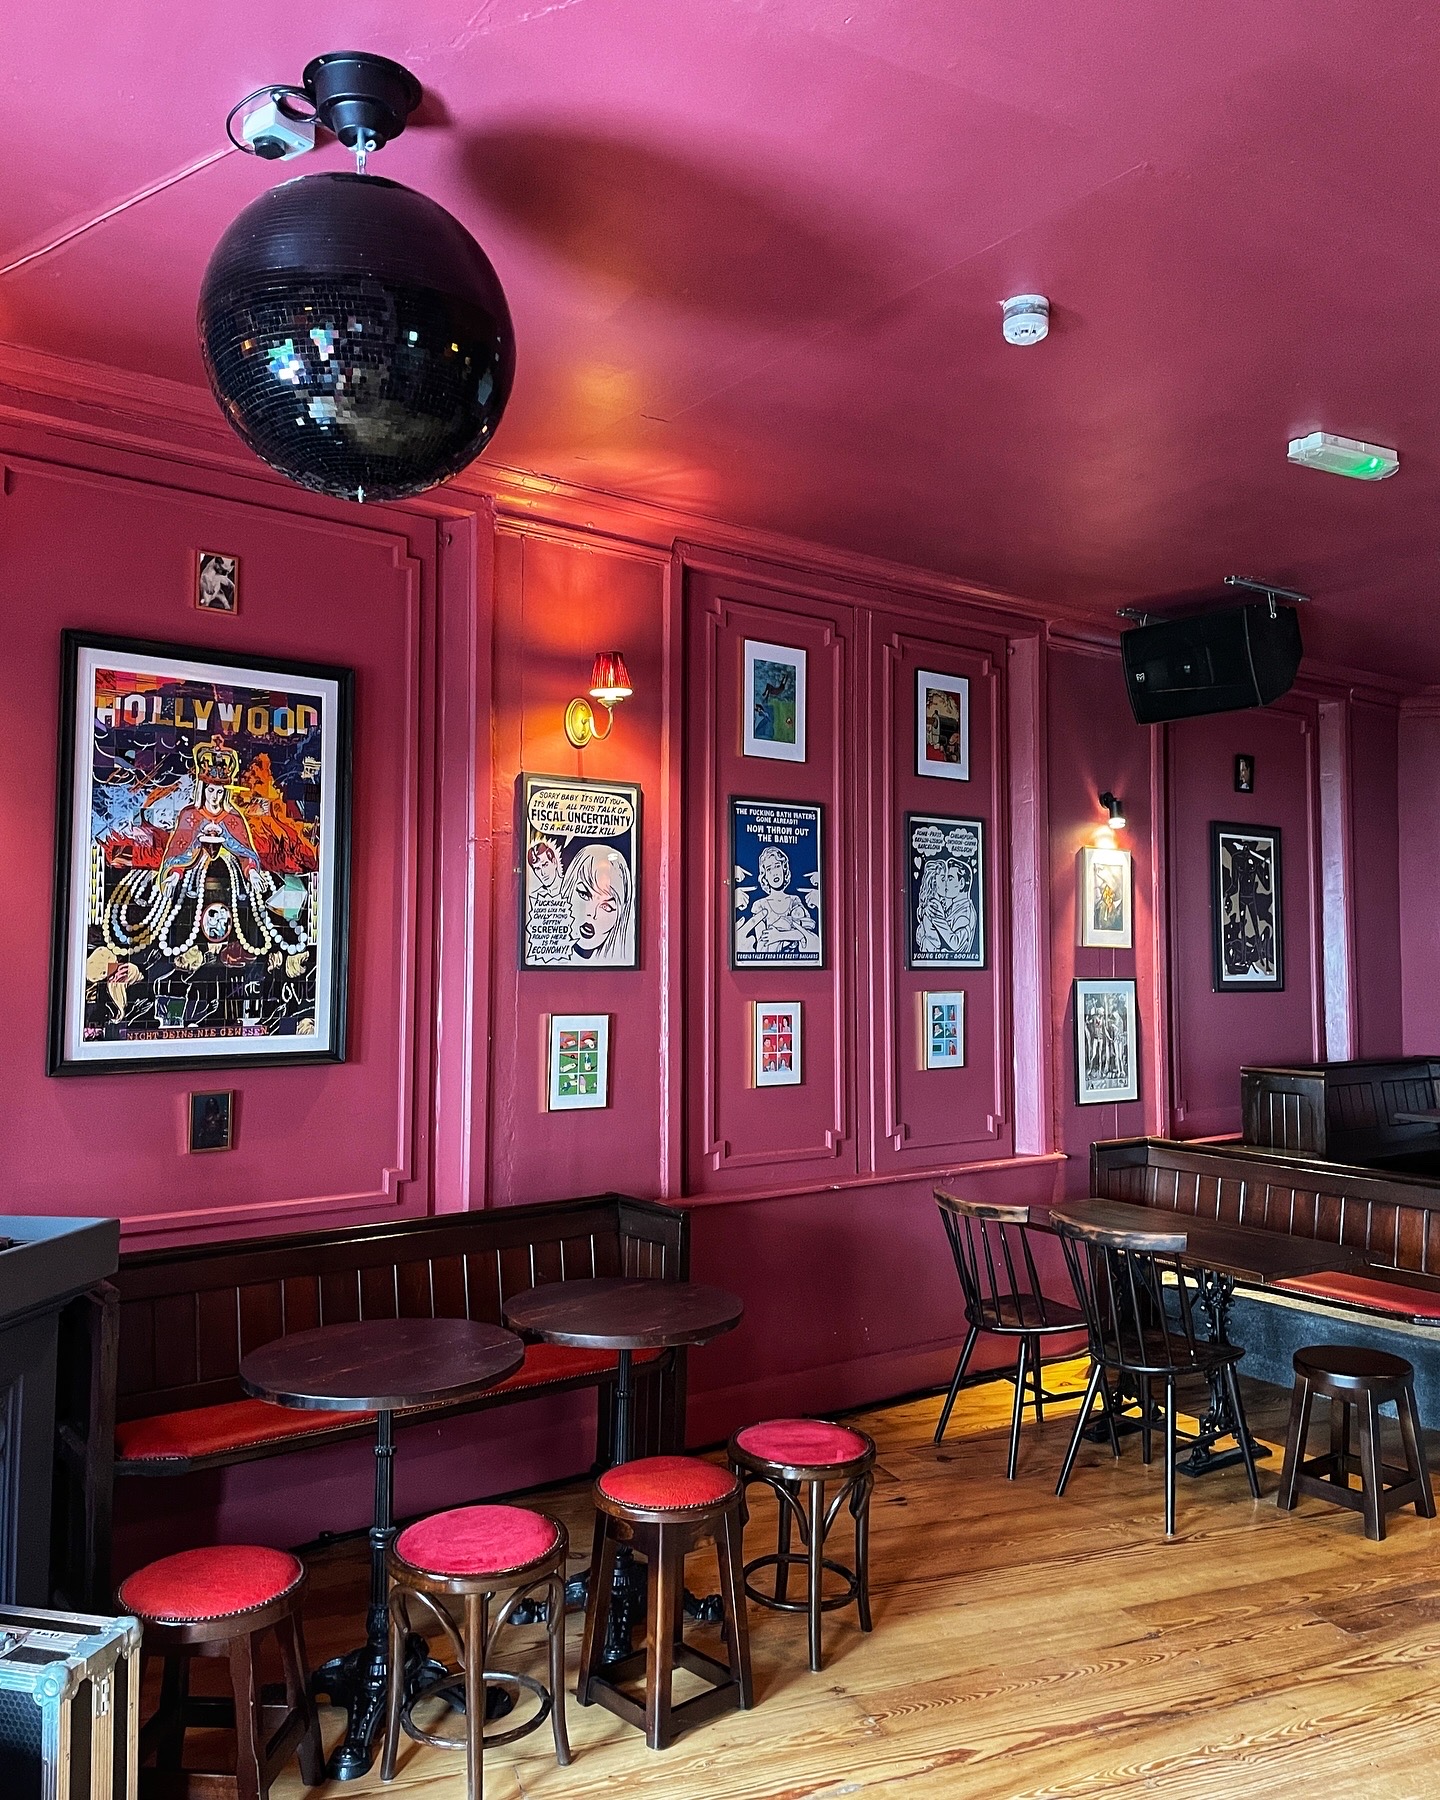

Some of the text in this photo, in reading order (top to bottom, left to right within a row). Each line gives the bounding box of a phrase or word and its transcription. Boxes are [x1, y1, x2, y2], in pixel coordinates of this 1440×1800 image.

[96, 694, 318, 736] HOLLYWOOD
[540, 791, 560, 800] SORRY
[561, 793, 579, 801] BABY
[594, 796, 609, 805] NOT
[597, 805, 616, 813] TALK
[749, 808, 775, 817] FUCKING
[531, 809, 631, 827] FISCAL UNCERTAINTY
[755, 816, 772, 824] GONE
[540, 823, 549, 831] IS
[575, 825, 598, 834] BUZZ
[598, 827, 616, 835] KILL
[746, 824, 809, 836] NOW THROW OUT
[757, 833, 772, 843] THE
[531, 945, 570, 955] ECONOMY!
[913, 952, 934, 960] YOUNG
[934, 952, 949, 960] LOVE
[127, 1030, 159, 1041] NICHT
